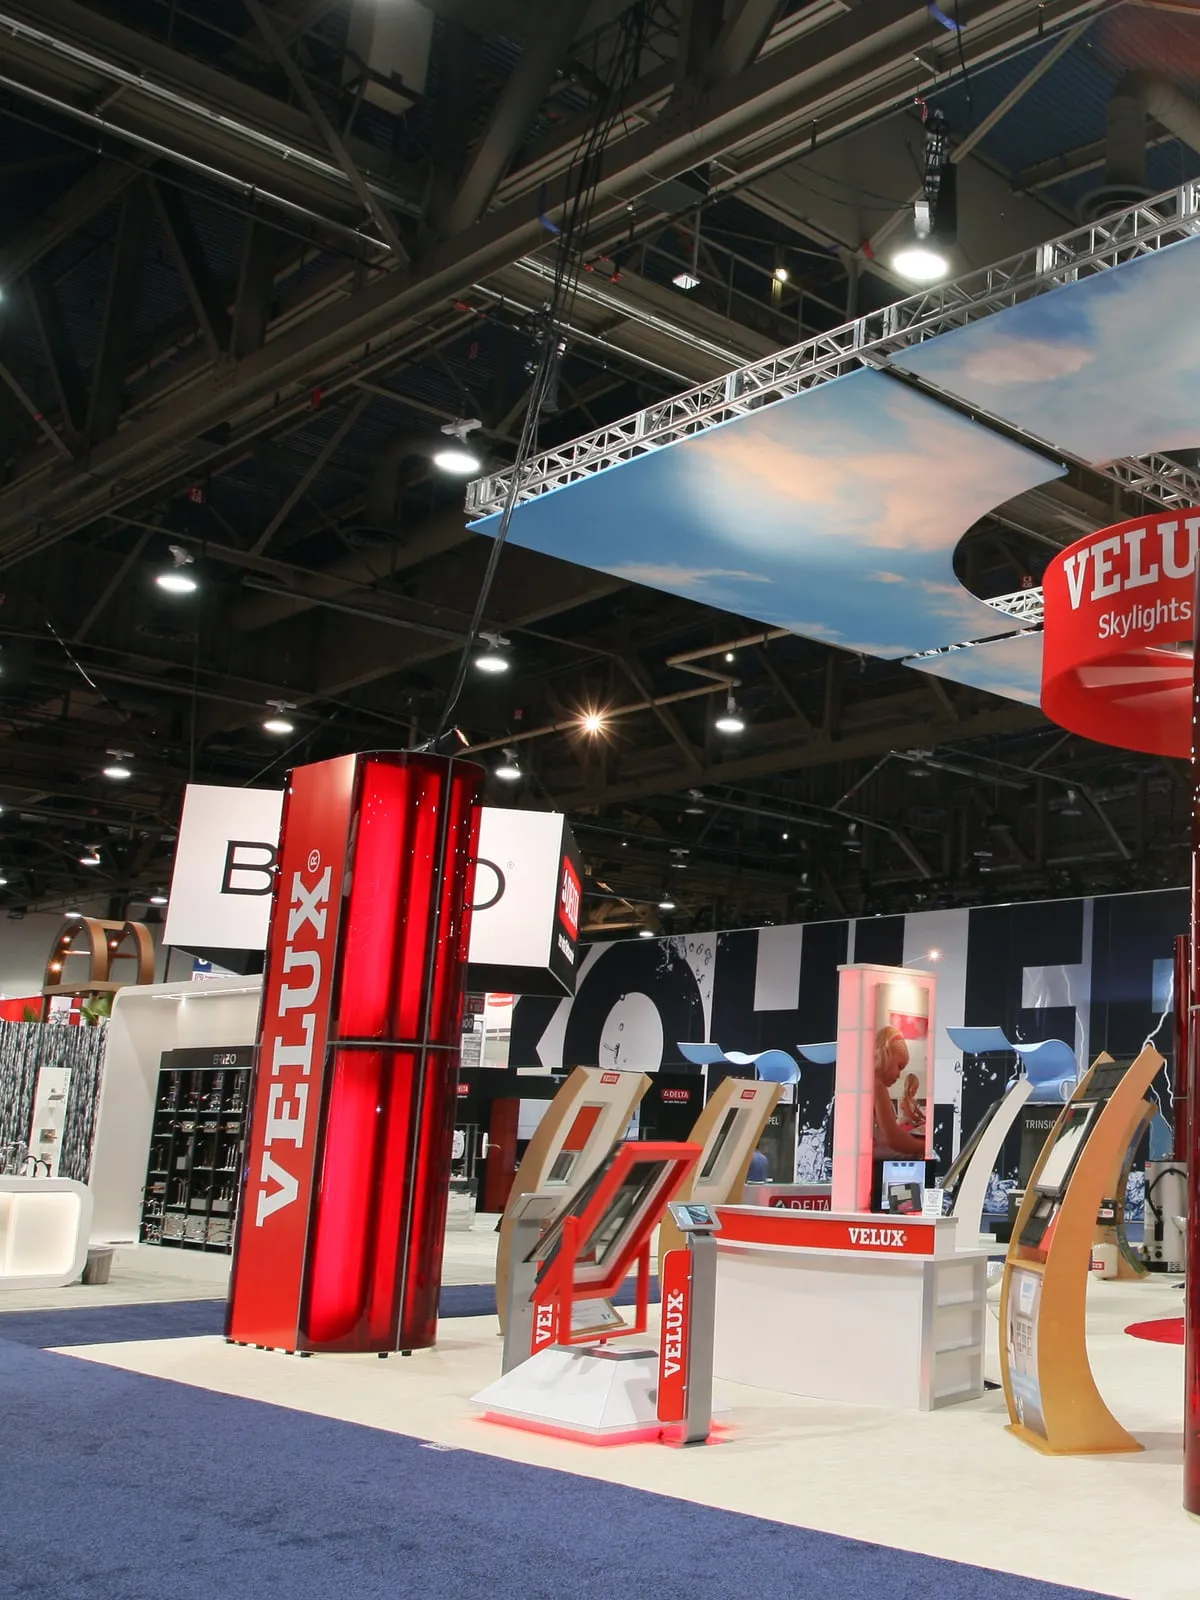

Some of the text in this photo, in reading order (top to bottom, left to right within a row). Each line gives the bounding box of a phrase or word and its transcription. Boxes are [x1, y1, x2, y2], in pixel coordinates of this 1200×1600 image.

[1098, 597, 1192, 639] Skylights
[256, 866, 332, 1227] VELUX
[669, 1091, 689, 1099] DELTA
[848, 1228, 905, 1247] VELUX
[536, 1302, 553, 1344] VEL
[664, 1292, 684, 1378] VELUX
